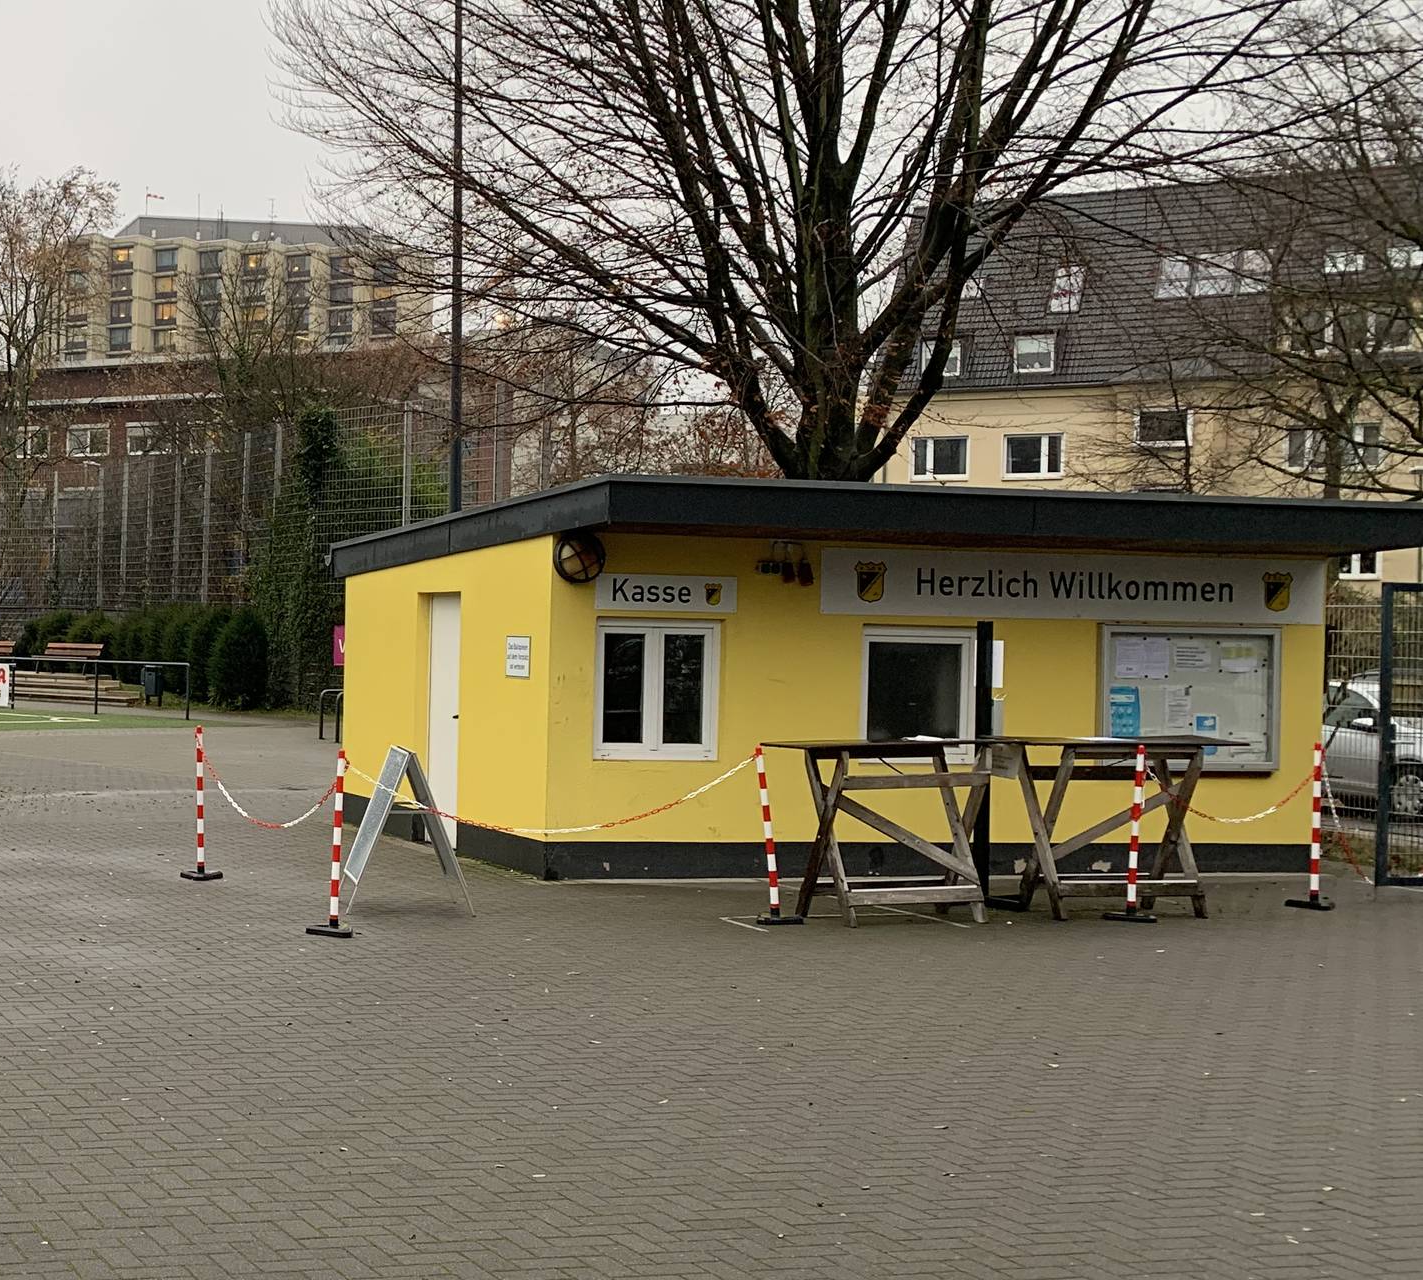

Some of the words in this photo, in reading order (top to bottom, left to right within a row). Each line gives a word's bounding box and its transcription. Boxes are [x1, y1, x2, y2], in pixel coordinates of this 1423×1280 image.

[612, 577, 691, 603] Kasse
[916, 567, 1038, 599] Herzlich
[1048, 571, 1234, 603] Willkommen
